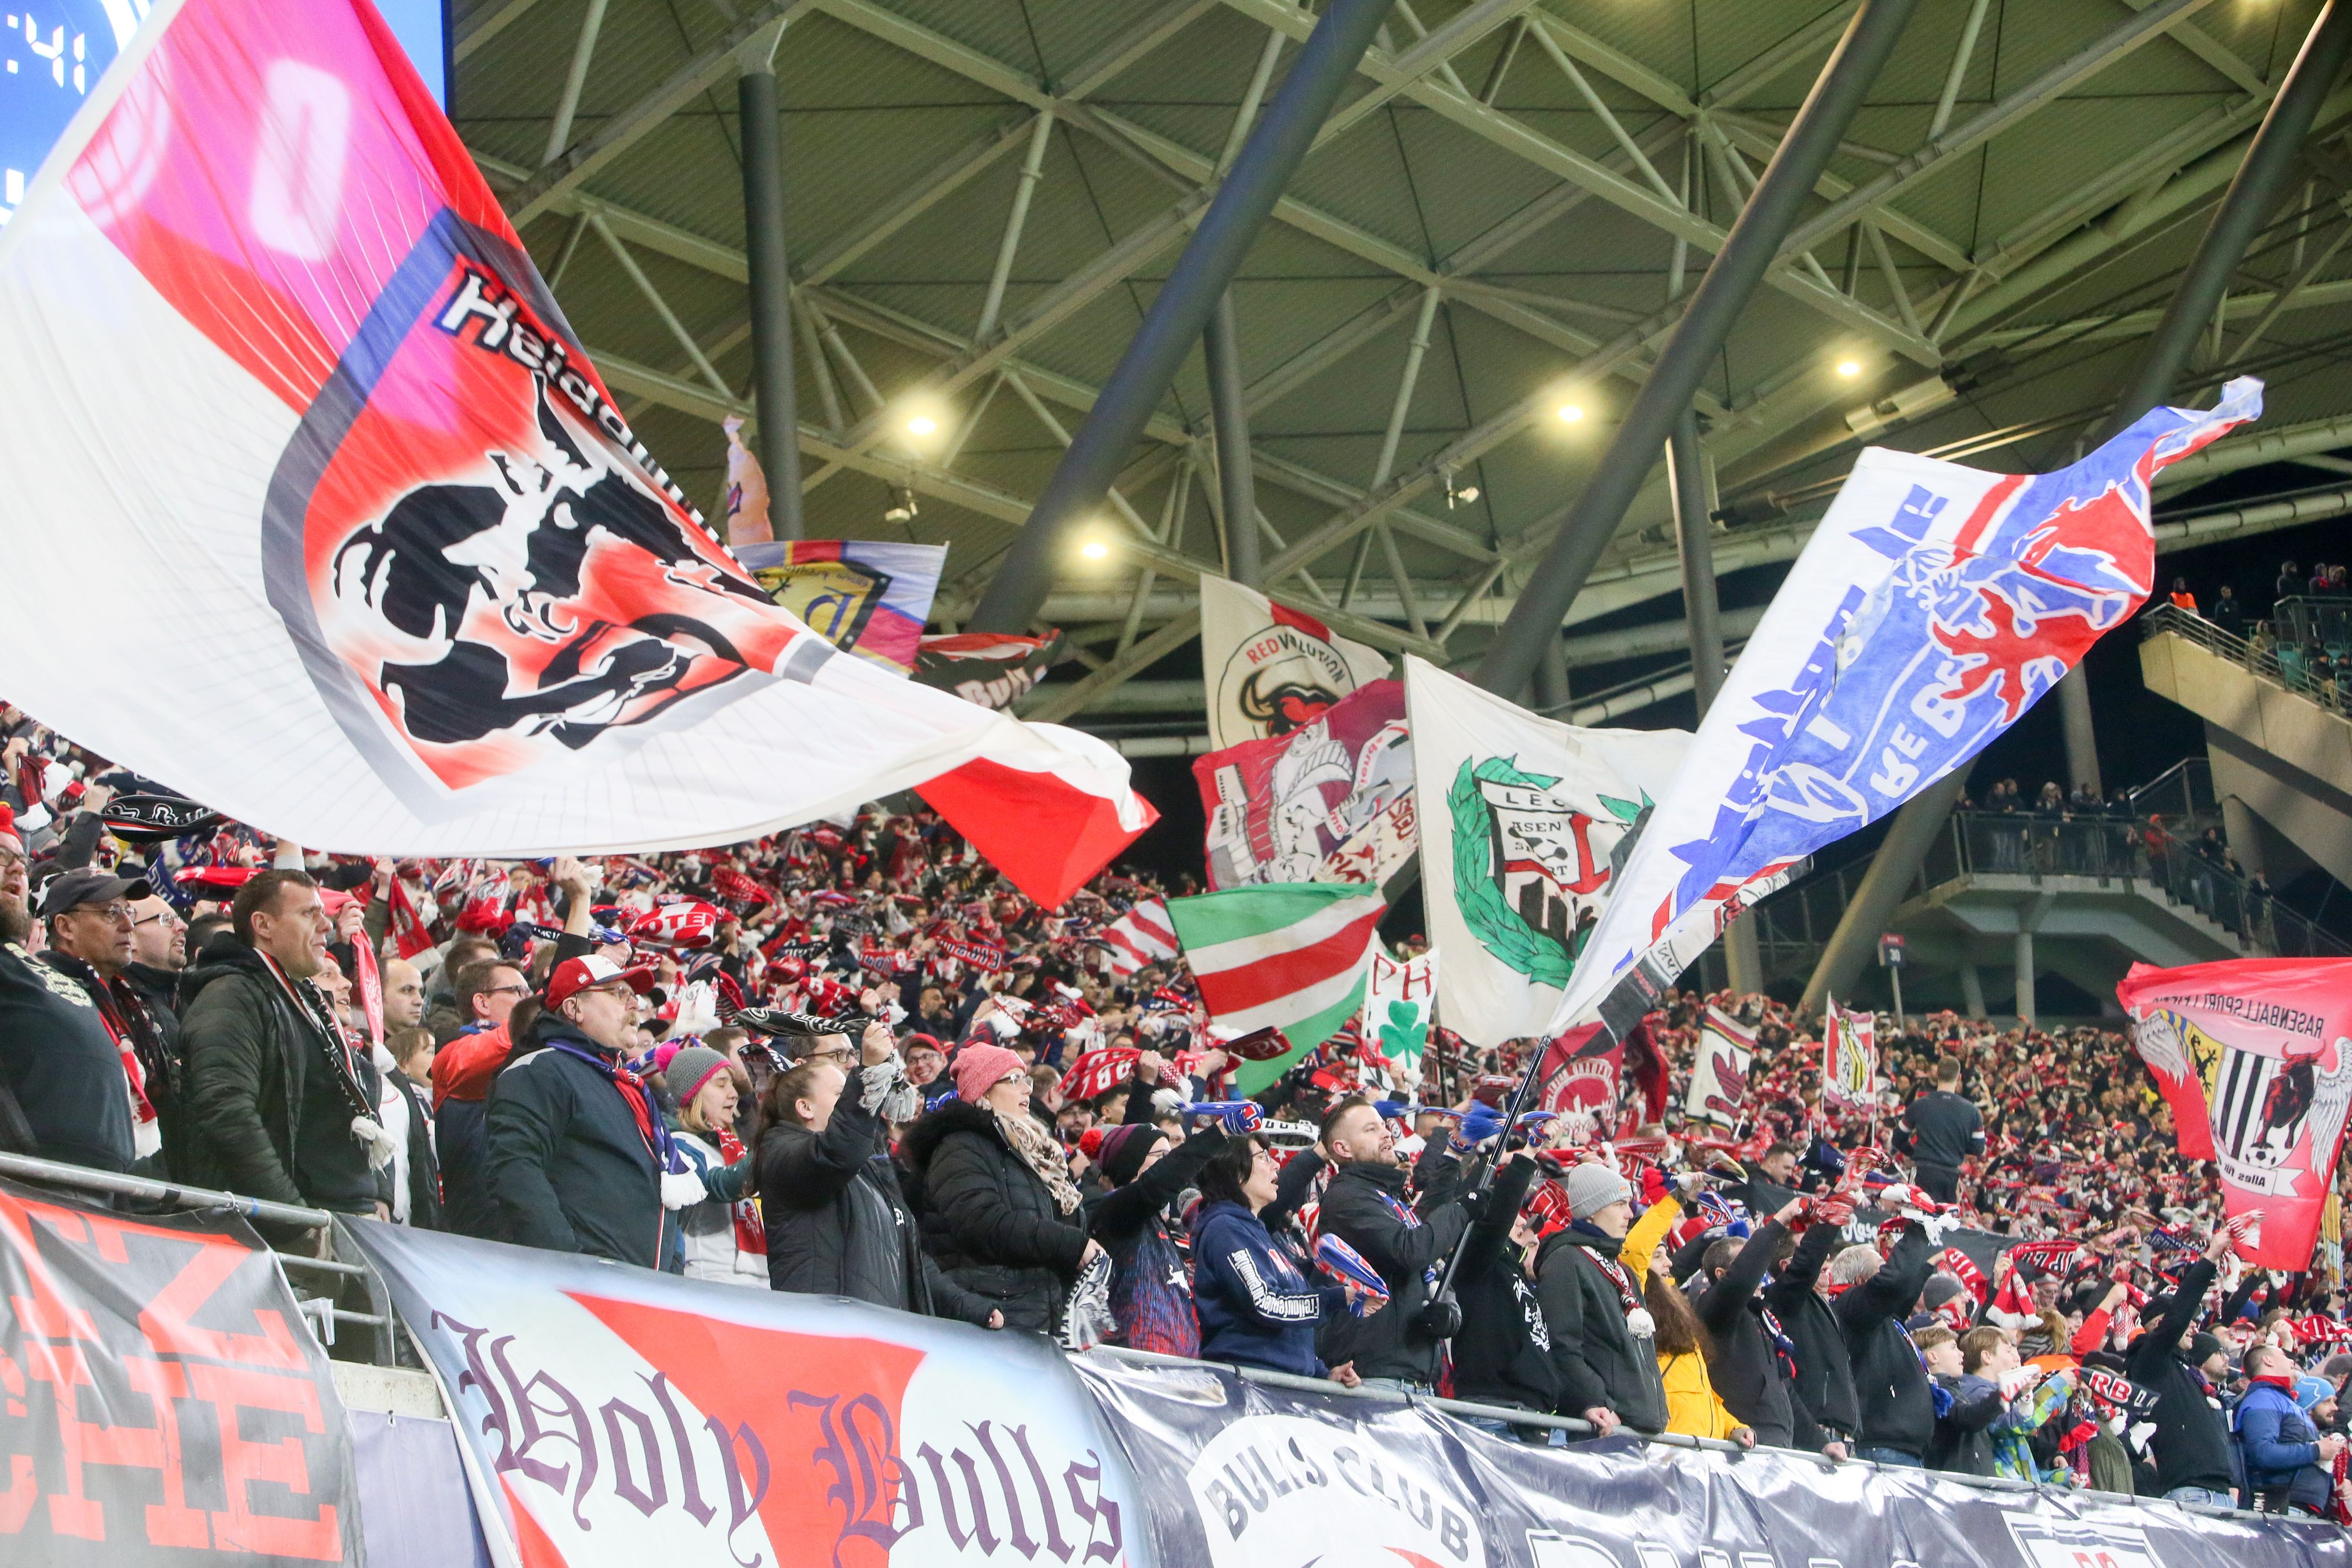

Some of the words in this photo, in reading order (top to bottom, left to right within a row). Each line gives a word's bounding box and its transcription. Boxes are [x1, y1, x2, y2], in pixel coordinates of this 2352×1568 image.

[430, 1309, 770, 1568] Holy
[787, 1389, 1122, 1568] Bulls
[2089, 1370, 2133, 1404] RB
[1204, 1436, 1329, 1542] BULLS
[1333, 1446, 1469, 1562] CLUB
